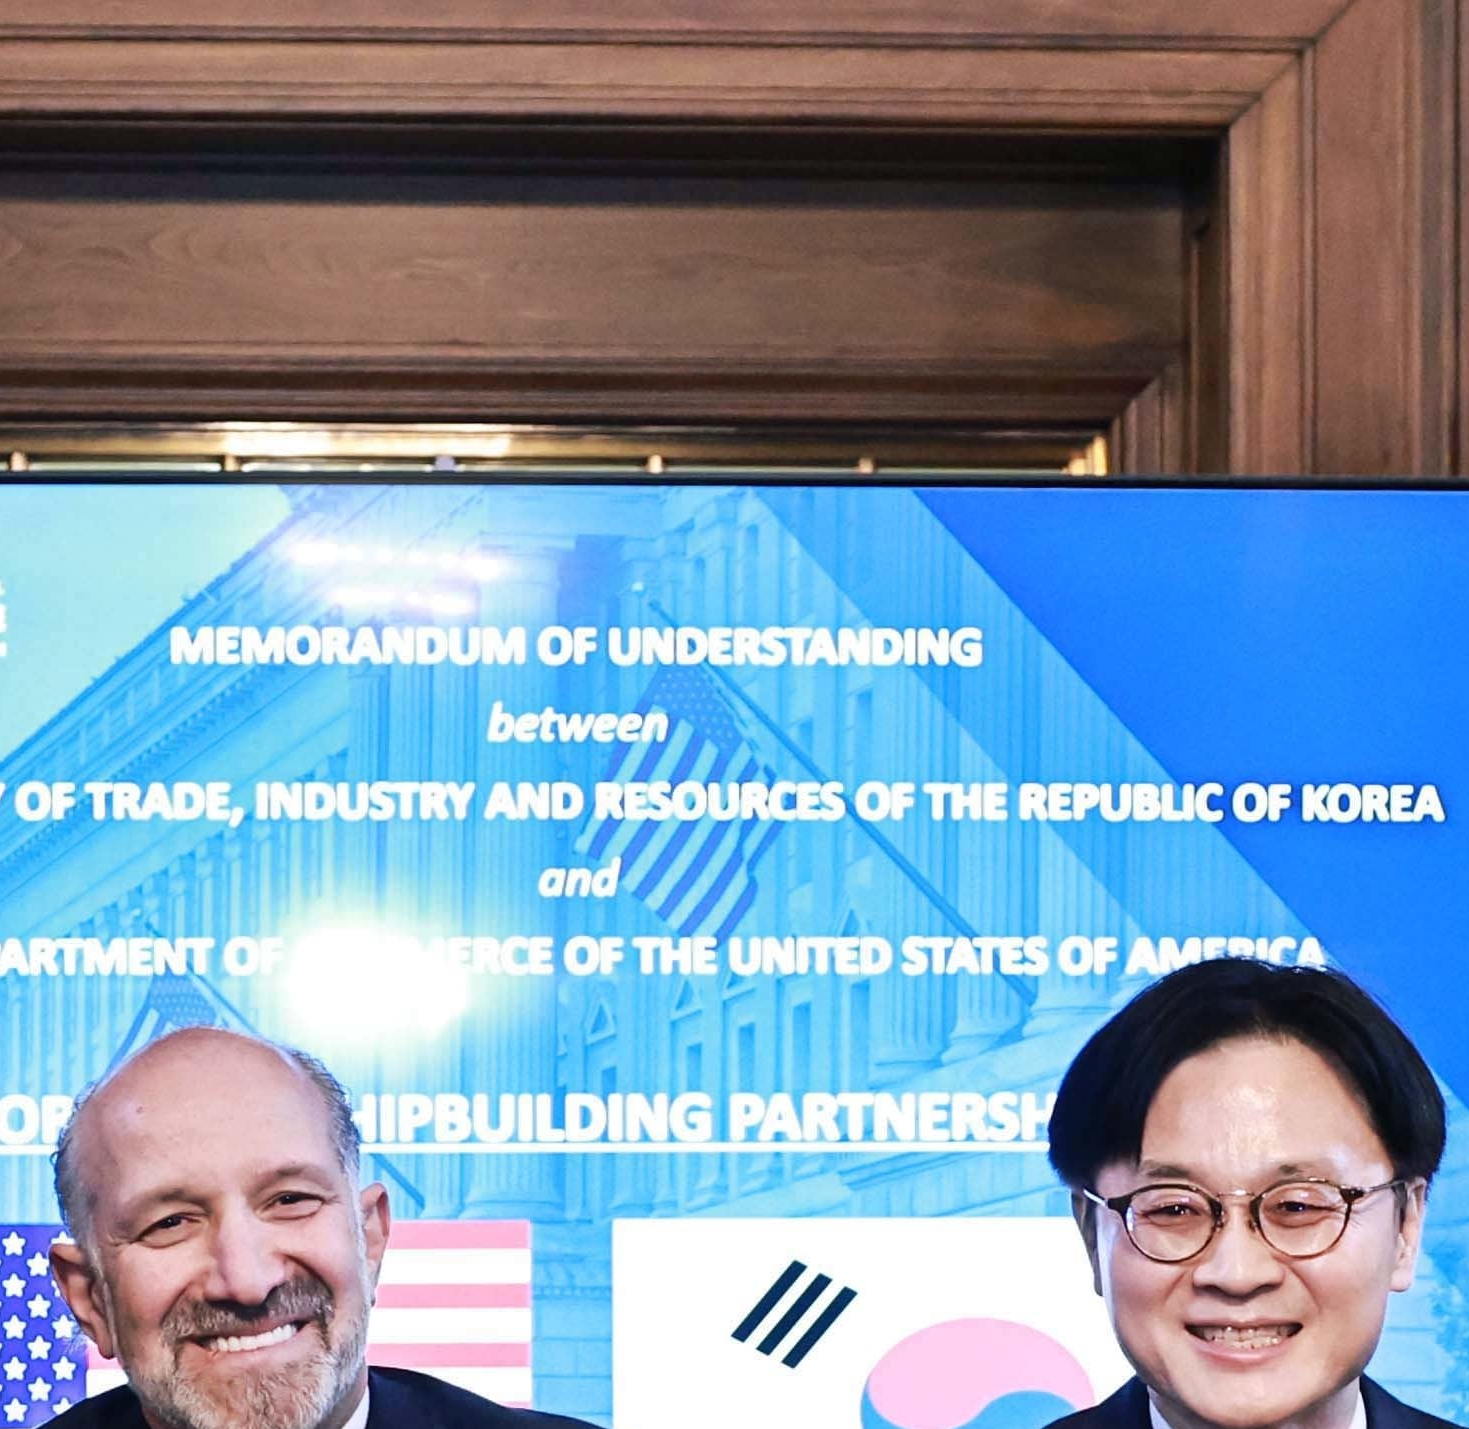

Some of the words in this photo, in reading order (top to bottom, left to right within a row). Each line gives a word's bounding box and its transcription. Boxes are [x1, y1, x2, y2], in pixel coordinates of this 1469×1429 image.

[170, 626, 526, 665] MEMORANDUM
[537, 626, 598, 665] OF
[608, 626, 984, 667] UNDERSTANDING
[487, 701, 669, 743] between
[15, 782, 75, 822] OF
[84, 781, 245, 828] TRADE,
[255, 781, 475, 822] INDUSTRY
[483, 781, 584, 821] AND
[595, 781, 847, 821] RESOURCES
[855, 781, 916, 821] OF
[923, 782, 1009, 821] THE
[1019, 782, 1224, 823] REPUBLIC
[1232, 783, 1292, 823] OF
[1302, 784, 1446, 823] KOREA
[538, 855, 622, 898] and
[222, 936, 285, 976] OF
[563, 936, 625, 976] OF
[632, 936, 717, 976] THE
[728, 936, 893, 976] UNITED
[901, 936, 1050, 976] STATES
[1058, 936, 1118, 976] OF
[351, 1092, 713, 1143] HIPBUILDING
[729, 1092, 1058, 1143] PARTNERSH
